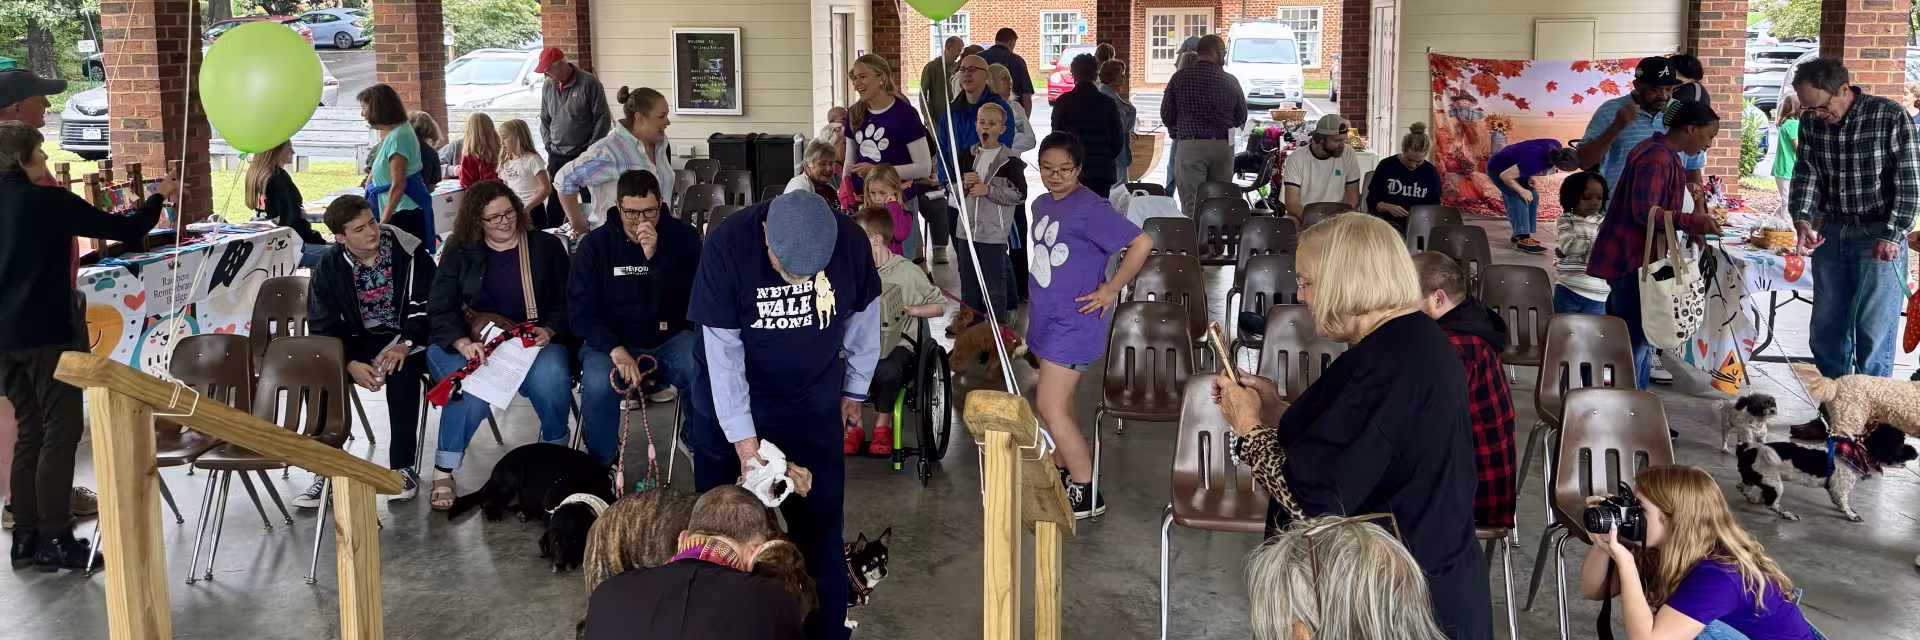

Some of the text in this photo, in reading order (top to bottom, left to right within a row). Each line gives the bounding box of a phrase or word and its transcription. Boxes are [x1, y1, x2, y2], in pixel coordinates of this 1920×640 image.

[1658, 65, 1670, 78] A
[1387, 178, 1428, 198] Duke
[162, 273, 190, 287] Raibow
[756, 280, 814, 299] NEVER
[166, 293, 188, 305] Bdge
[756, 295, 812, 318] WALK
[750, 314, 814, 329] ALONE
